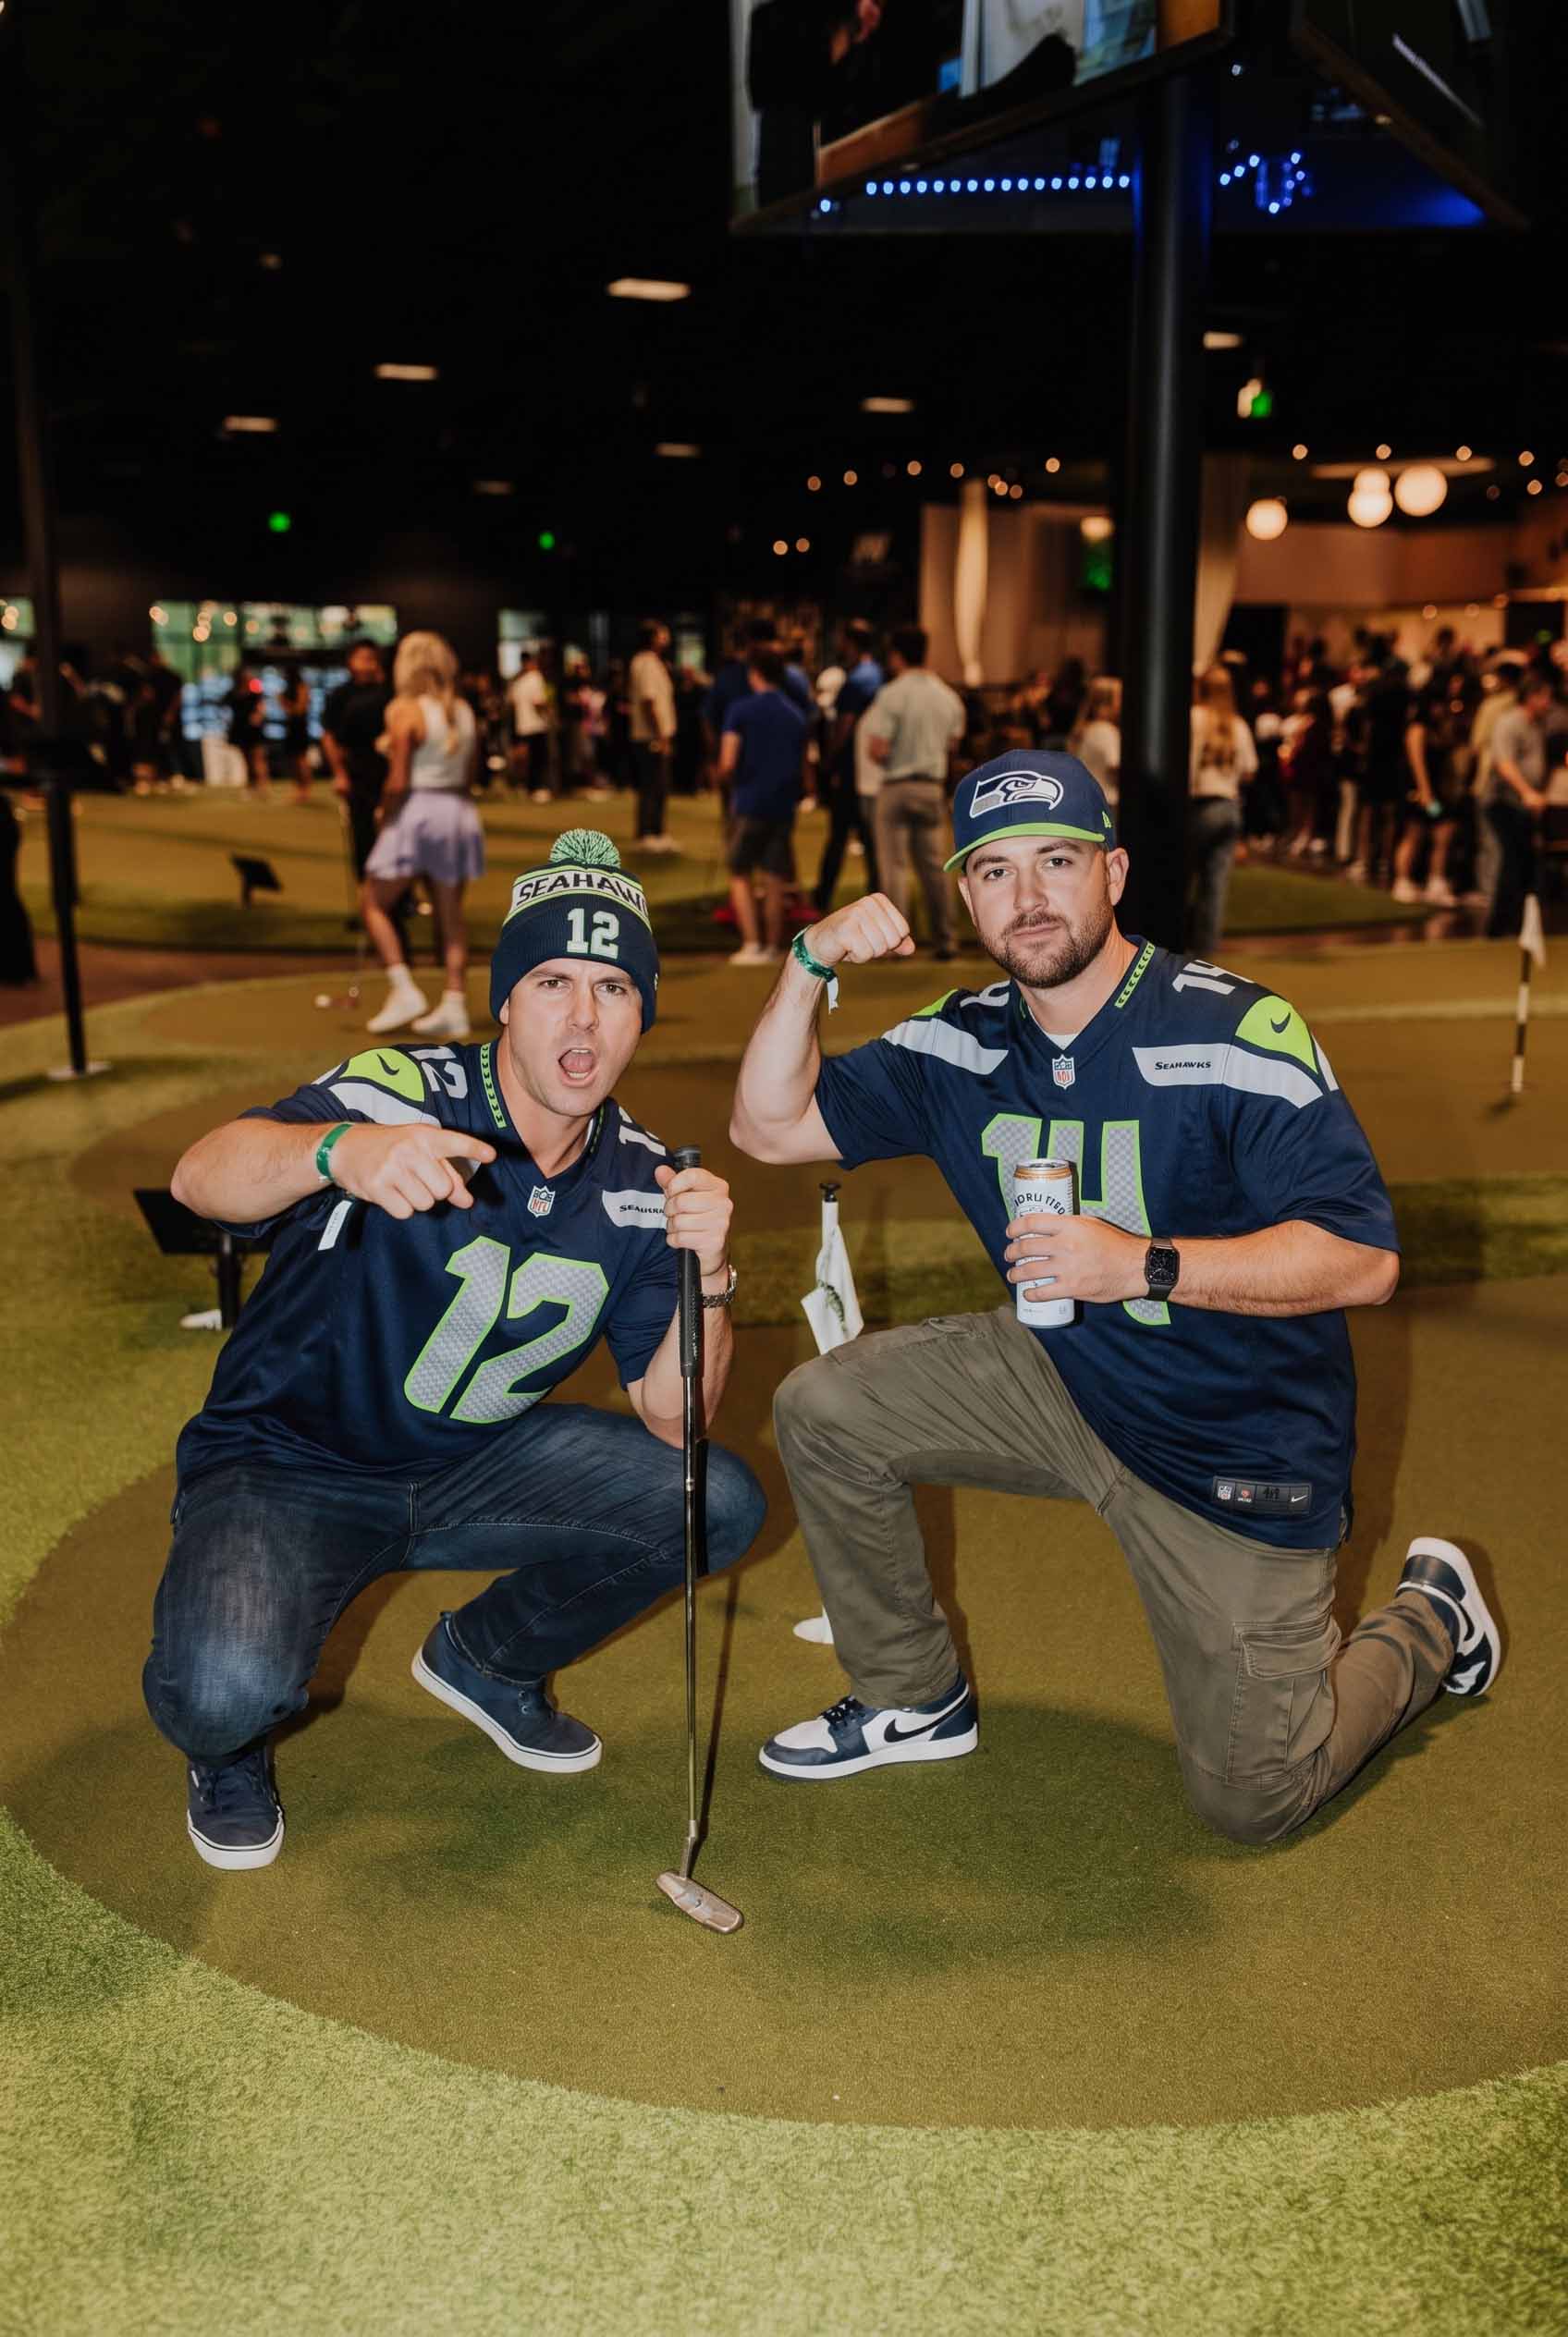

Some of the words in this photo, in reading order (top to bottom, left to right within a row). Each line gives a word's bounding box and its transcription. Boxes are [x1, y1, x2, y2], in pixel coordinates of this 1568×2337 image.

[567, 908, 620, 960] 12
[409, 1046, 468, 1099] 12
[1155, 1060, 1211, 1071] SEAHAWKS
[404, 1235, 610, 1424] 12
